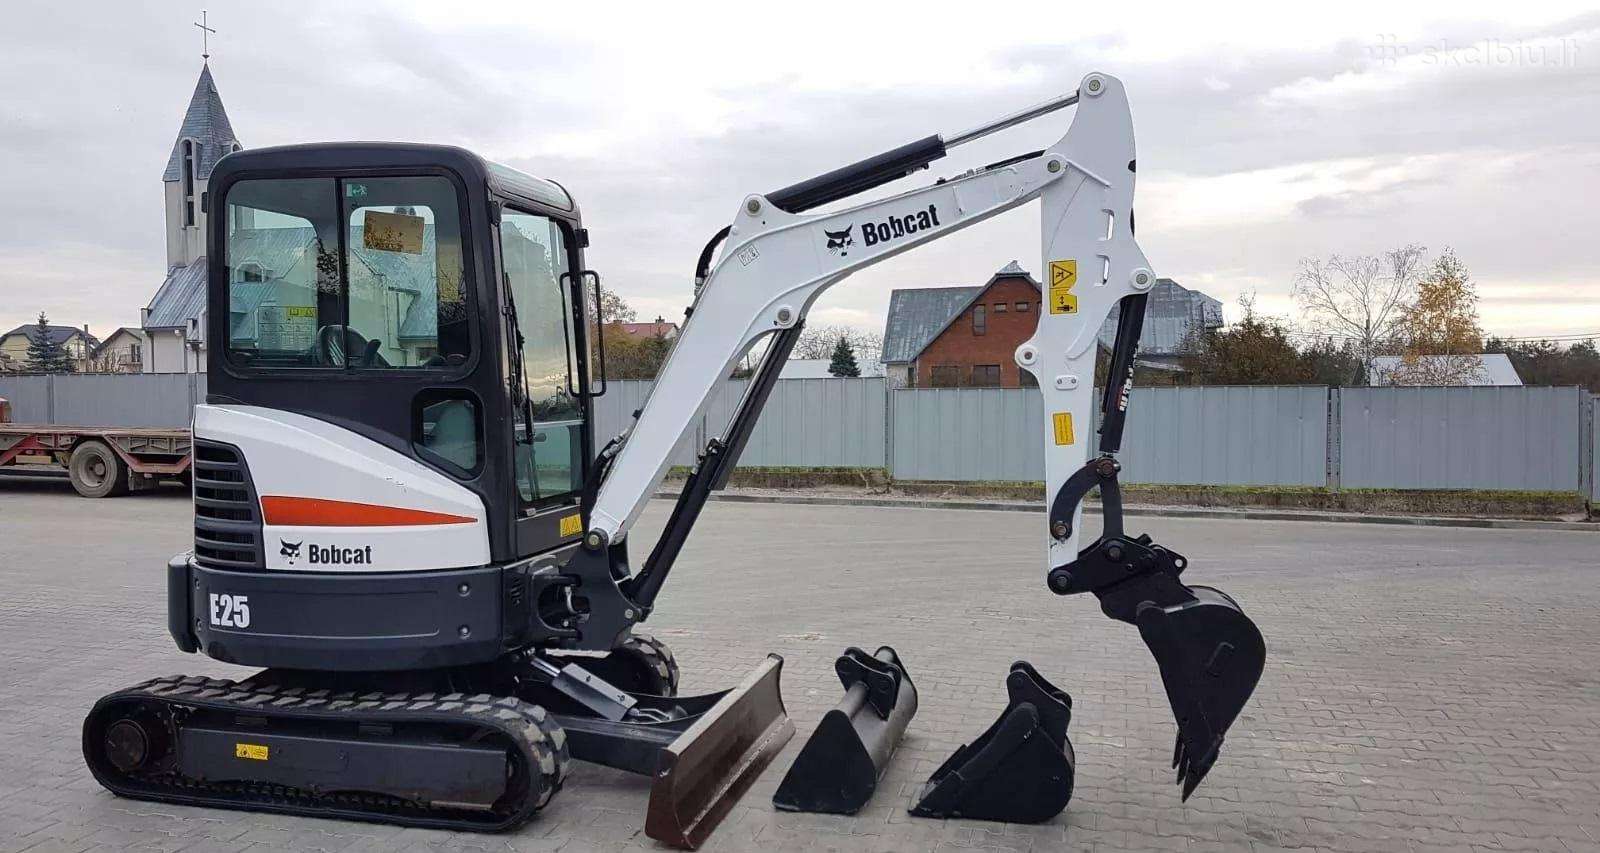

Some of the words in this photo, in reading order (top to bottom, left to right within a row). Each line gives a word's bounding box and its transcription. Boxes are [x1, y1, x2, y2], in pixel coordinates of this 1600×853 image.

[862, 204, 940, 246] Bobcat
[309, 544, 372, 564] Bobcat
[209, 593, 250, 628] E25
